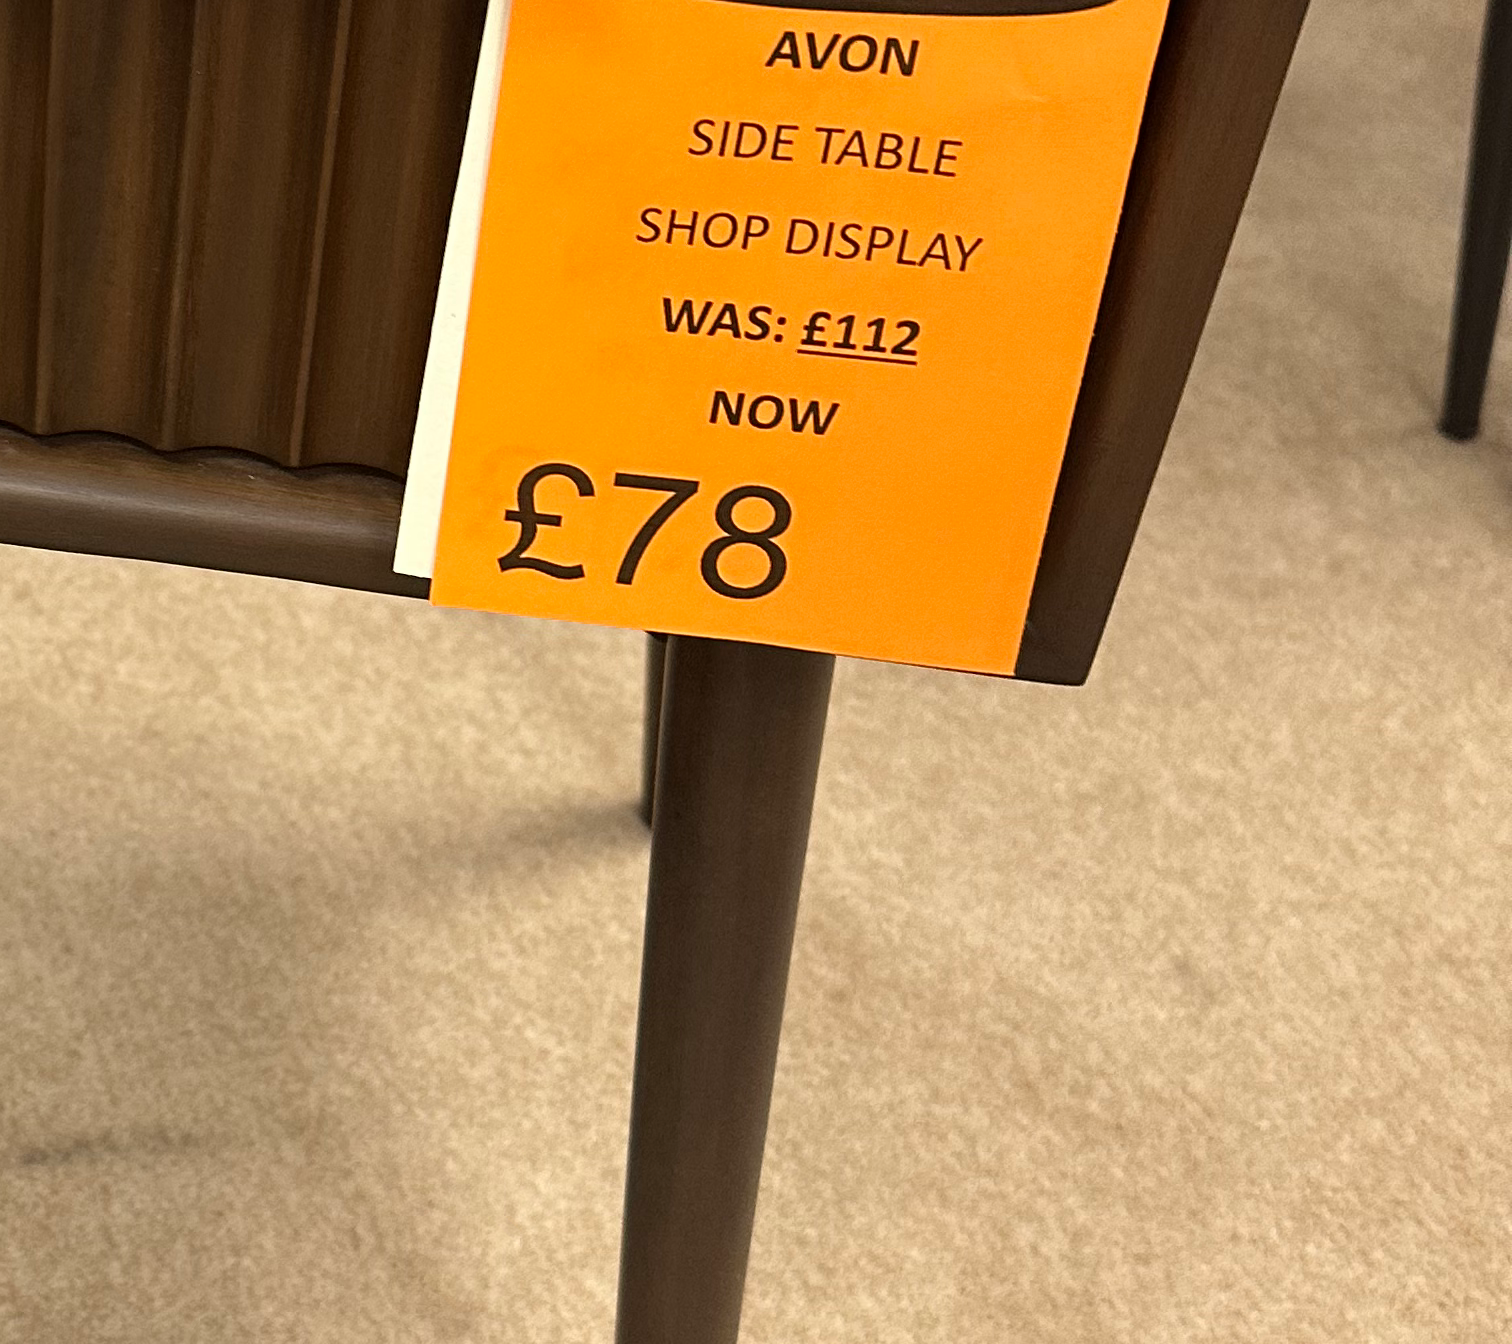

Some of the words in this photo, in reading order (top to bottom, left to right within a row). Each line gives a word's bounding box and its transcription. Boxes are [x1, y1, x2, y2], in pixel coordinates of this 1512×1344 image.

[765, 30, 920, 77] AVON
[688, 118, 800, 162] SIDE
[814, 126, 963, 178] TABLE
[635, 207, 770, 251] SHOP
[784, 218, 983, 273] DISPLAY
[661, 296, 787, 344] WAS:
[796, 311, 921, 366] £112
[708, 390, 840, 436] NOW
[497, 462, 793, 600] £78
